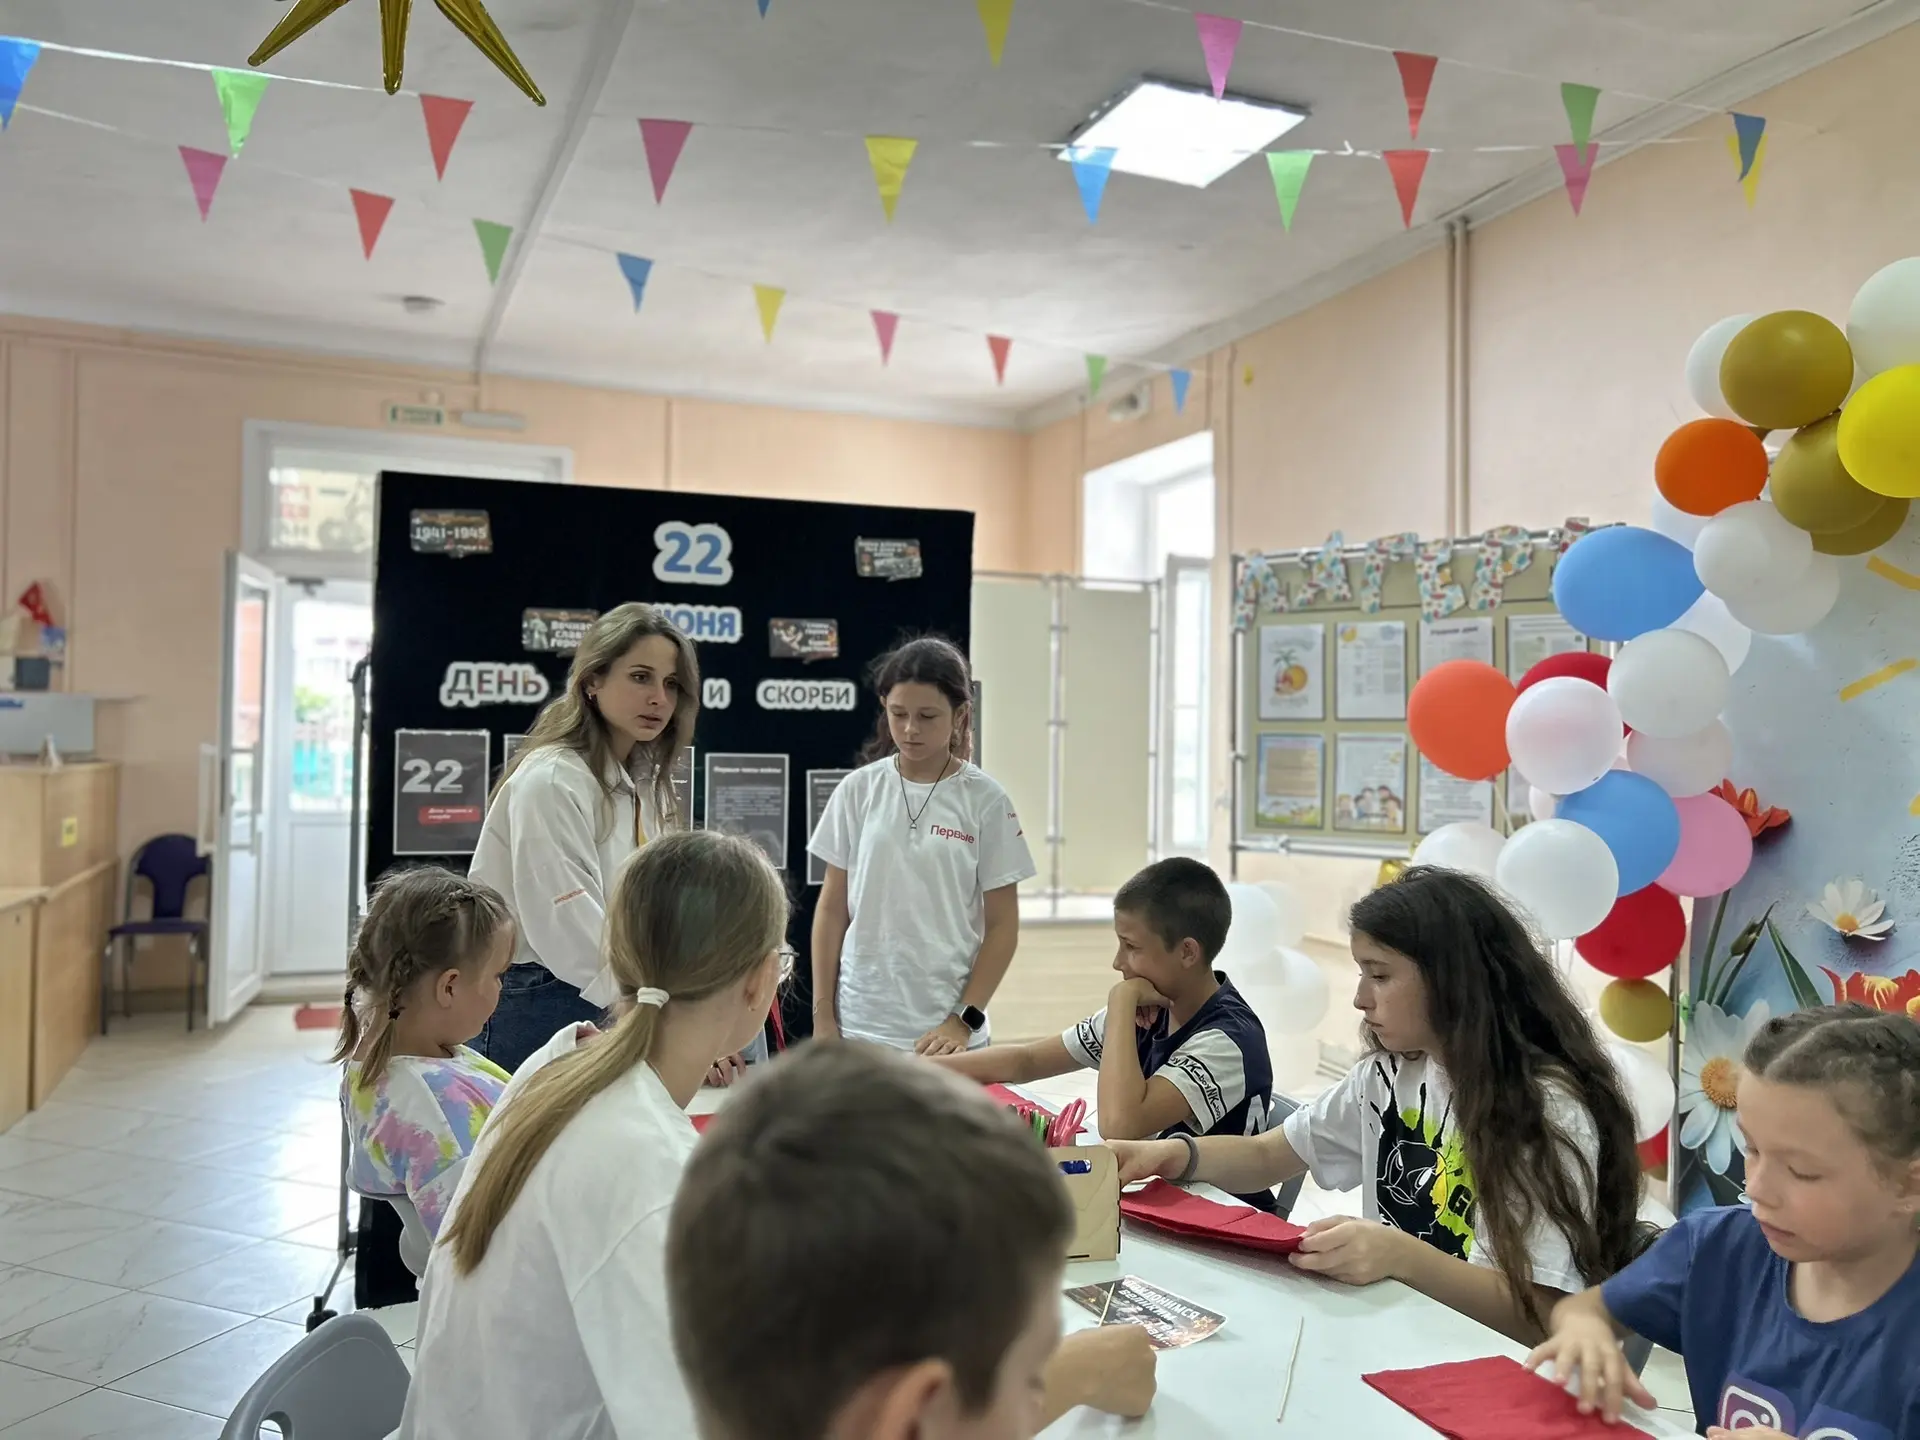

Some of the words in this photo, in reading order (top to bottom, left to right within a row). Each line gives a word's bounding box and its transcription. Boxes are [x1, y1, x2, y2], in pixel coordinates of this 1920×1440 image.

[416, 526, 487, 540] 1941-1945
[664, 530, 724, 576] 22
[656, 608, 735, 637] ЮНЯ
[447, 668, 542, 700] ДЕНЬ
[708, 684, 724, 702] И
[763, 685, 850, 705] СКОРБИ
[402, 758, 463, 793] 22
[930, 824, 975, 844] Первые
